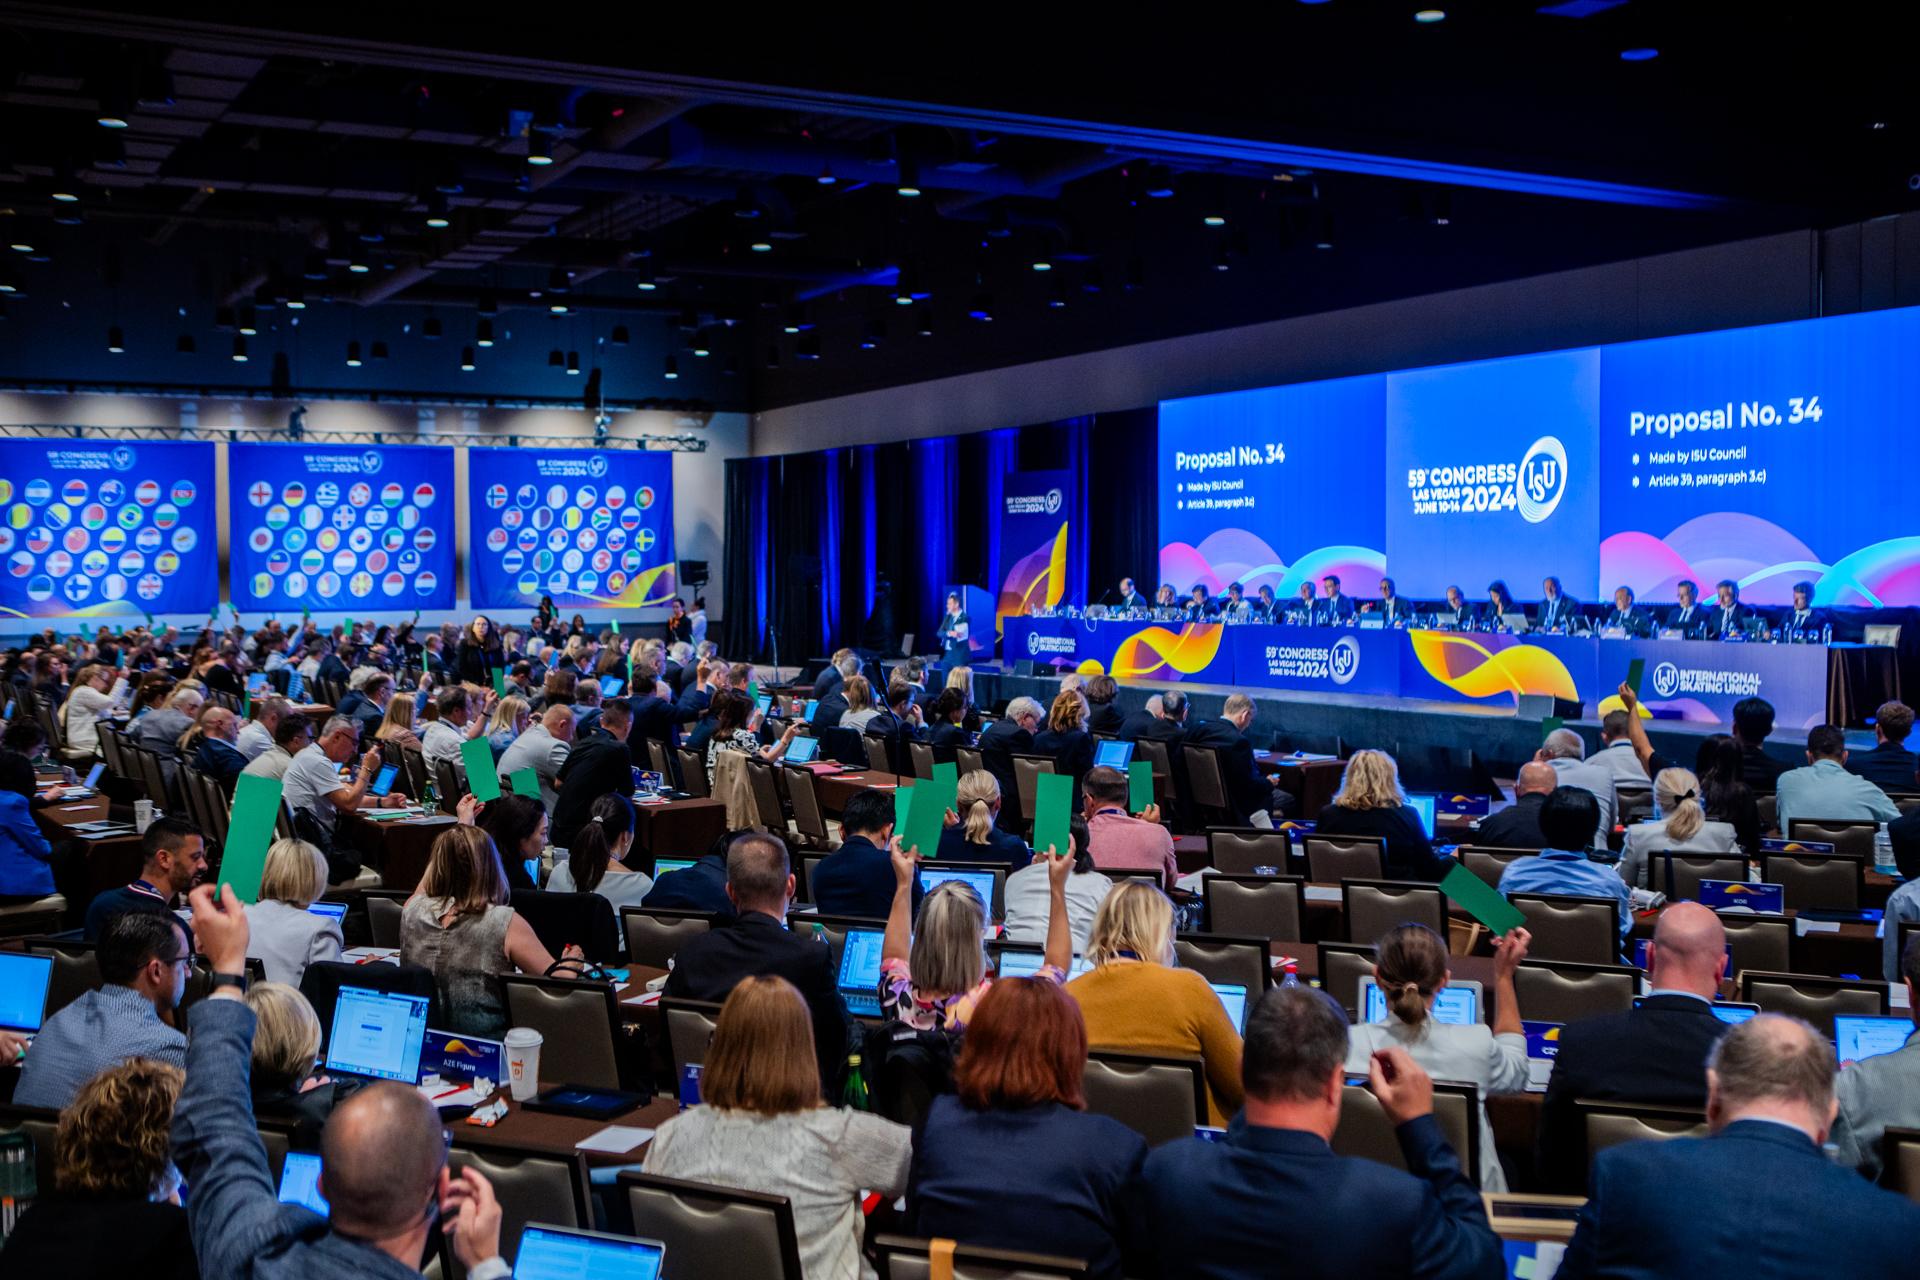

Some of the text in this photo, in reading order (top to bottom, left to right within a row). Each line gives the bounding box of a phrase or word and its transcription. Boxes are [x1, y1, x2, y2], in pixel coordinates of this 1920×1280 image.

[1630, 396, 1823, 438] Proposal No. 34
[1175, 442, 1286, 473] Proposal No. 34
[1649, 445, 1747, 465] Made by ISU Council
[1430, 463, 1517, 486] CONGRESS
[1528, 460, 1557, 502] ISU
[1649, 474, 1679, 488] Article
[1680, 472, 1694, 487] 39,
[1696, 470, 1747, 487] paragraph
[1187, 482, 1203, 492] Made
[1222, 479, 1244, 490] Council
[1412, 487, 1460, 501] LAS VEGAS
[1461, 485, 1517, 512] 2024
[1025, 503, 1045, 512] 2024
[1414, 499, 1460, 514] JUNE 10-14
[1279, 647, 1329, 661] CONGRESS
[1335, 649, 1351, 675] ISU
[1279, 660, 1296, 668] VEGAS
[1296, 661, 1329, 678] 2024
[1657, 669, 1675, 693] ISU
[1680, 669, 1762, 685] INTERNATIONAL
[1680, 680, 1758, 695] SKATING UNION
[1541, 1046, 1559, 1056] CZ
[443, 1058, 476, 1072] AZE Figure
